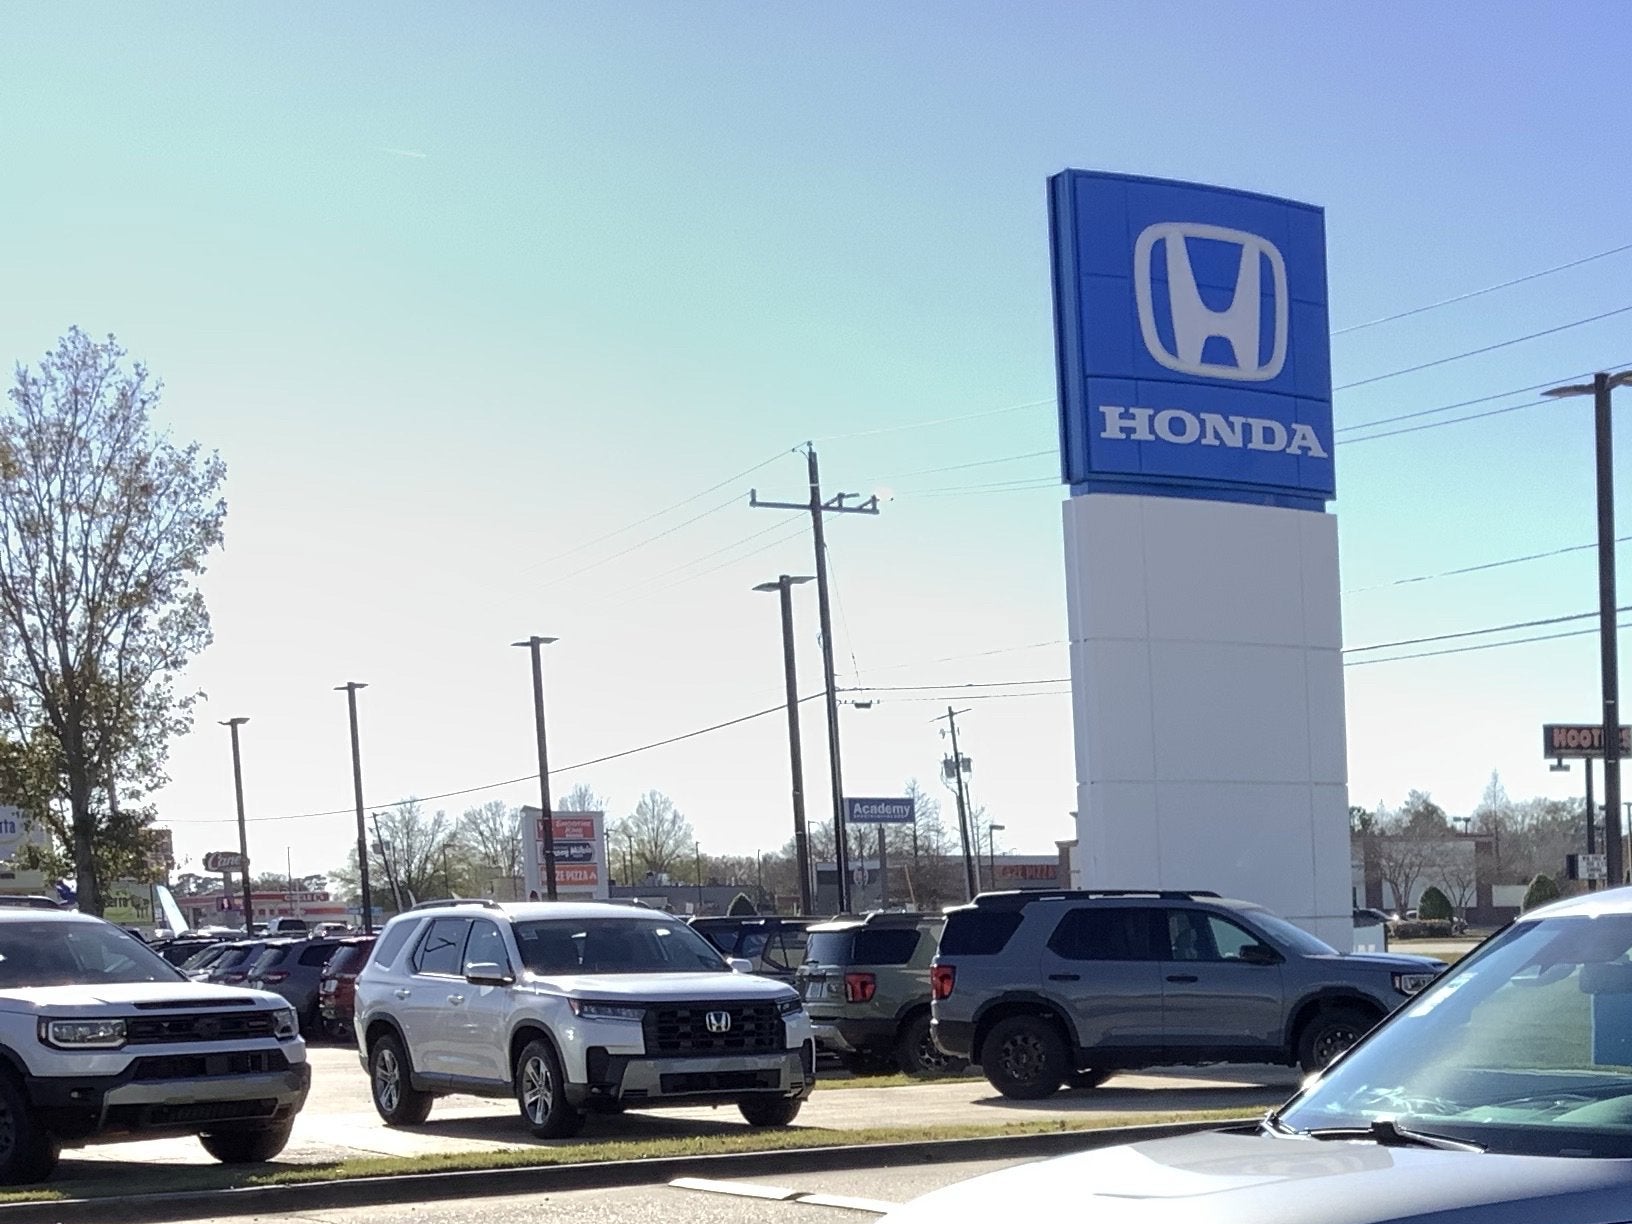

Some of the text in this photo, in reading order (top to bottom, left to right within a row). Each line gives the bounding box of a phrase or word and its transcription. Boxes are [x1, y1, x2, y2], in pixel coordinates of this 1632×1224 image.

[1099, 405, 1328, 459] HONDA
[853, 803, 911, 818] Academy
[567, 870, 589, 881] PIZZA
